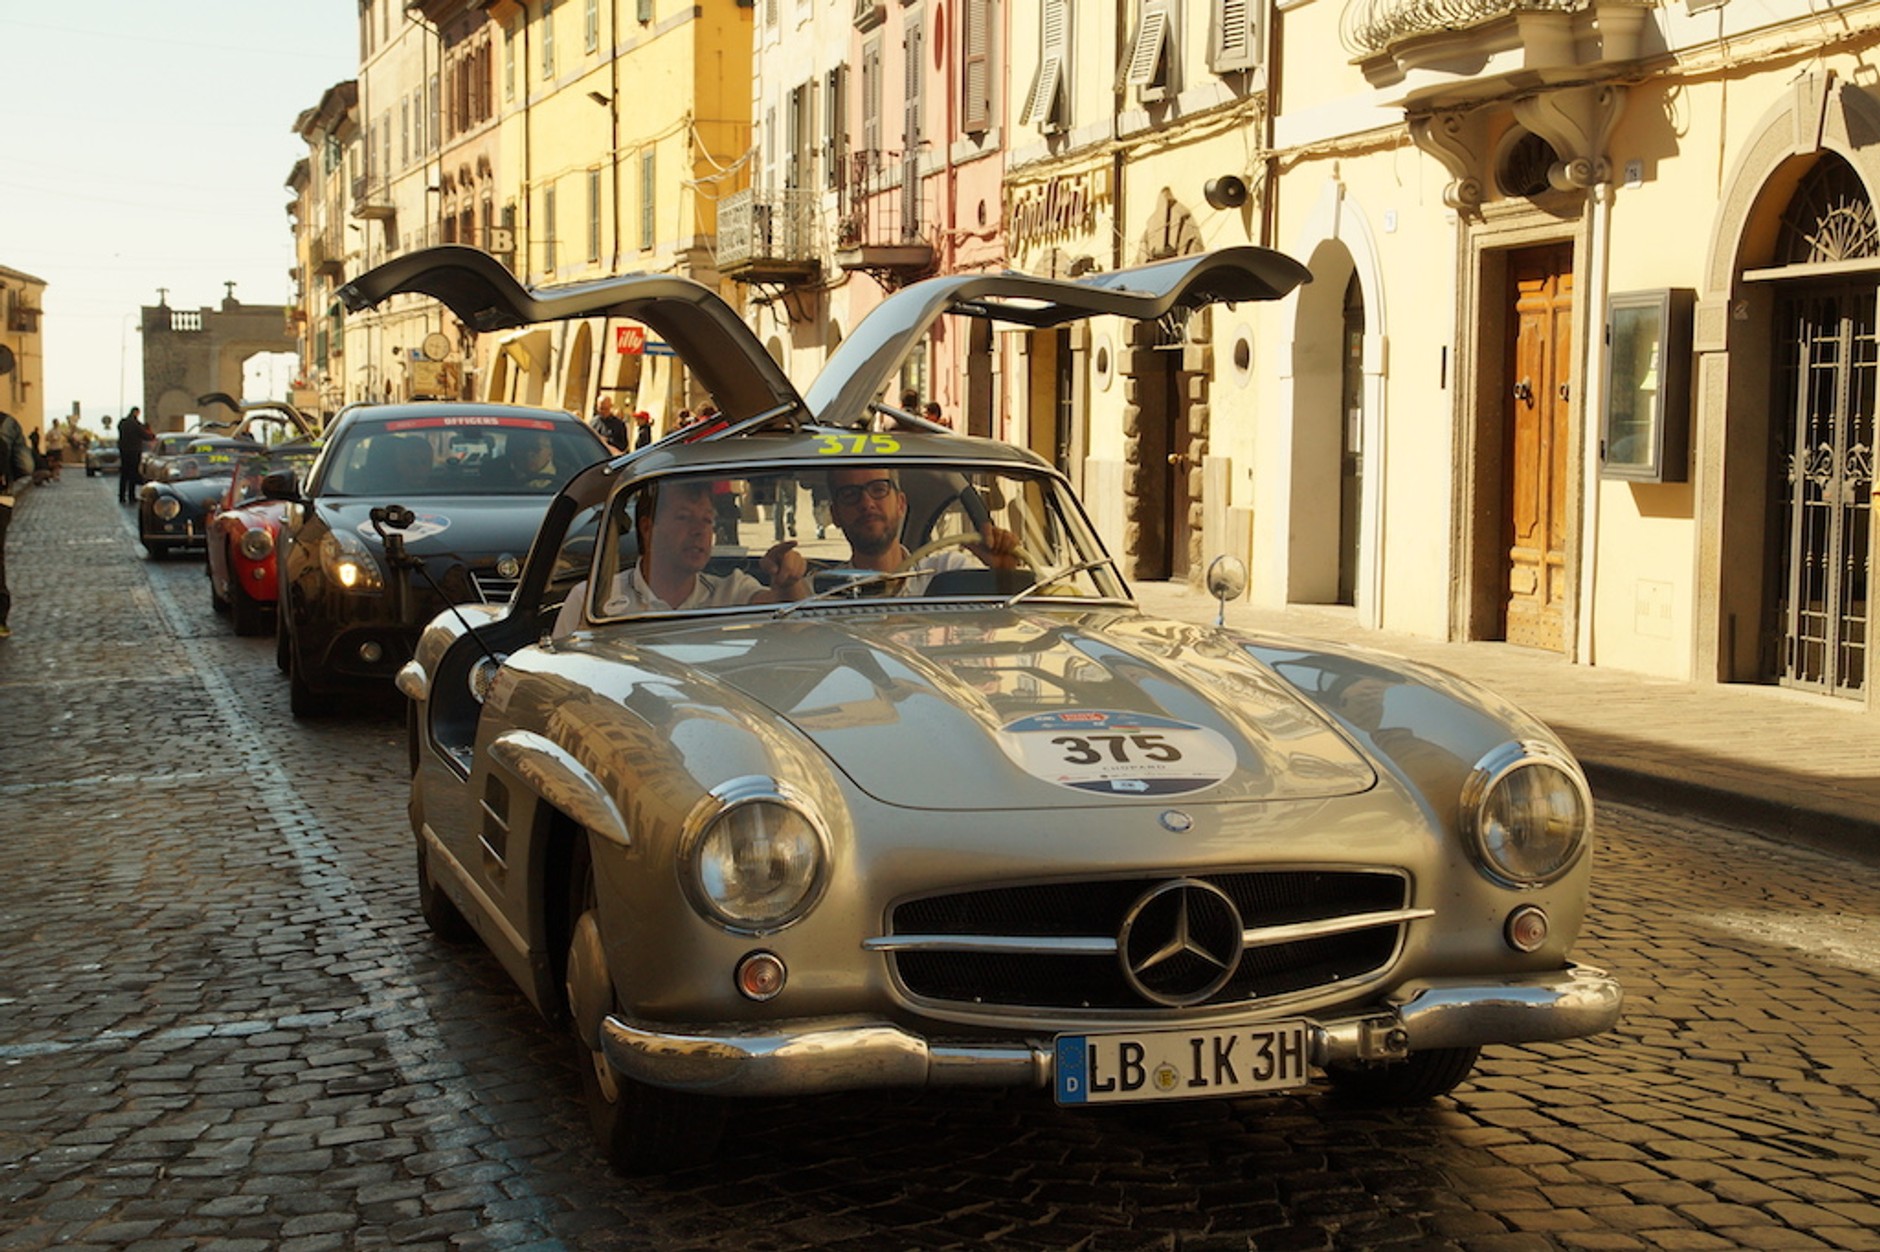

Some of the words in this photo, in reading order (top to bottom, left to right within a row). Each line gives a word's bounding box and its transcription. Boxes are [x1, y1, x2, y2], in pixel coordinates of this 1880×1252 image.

[490, 229, 514, 252] B
[618, 330, 643, 352] illy
[811, 434, 900, 454] 375
[1051, 734, 1183, 766] 375
[1088, 1041, 1146, 1093] LB
[1188, 1034, 1239, 1088] IK
[1251, 1029, 1304, 1082] 3H
[1066, 1076, 1079, 1093] D
